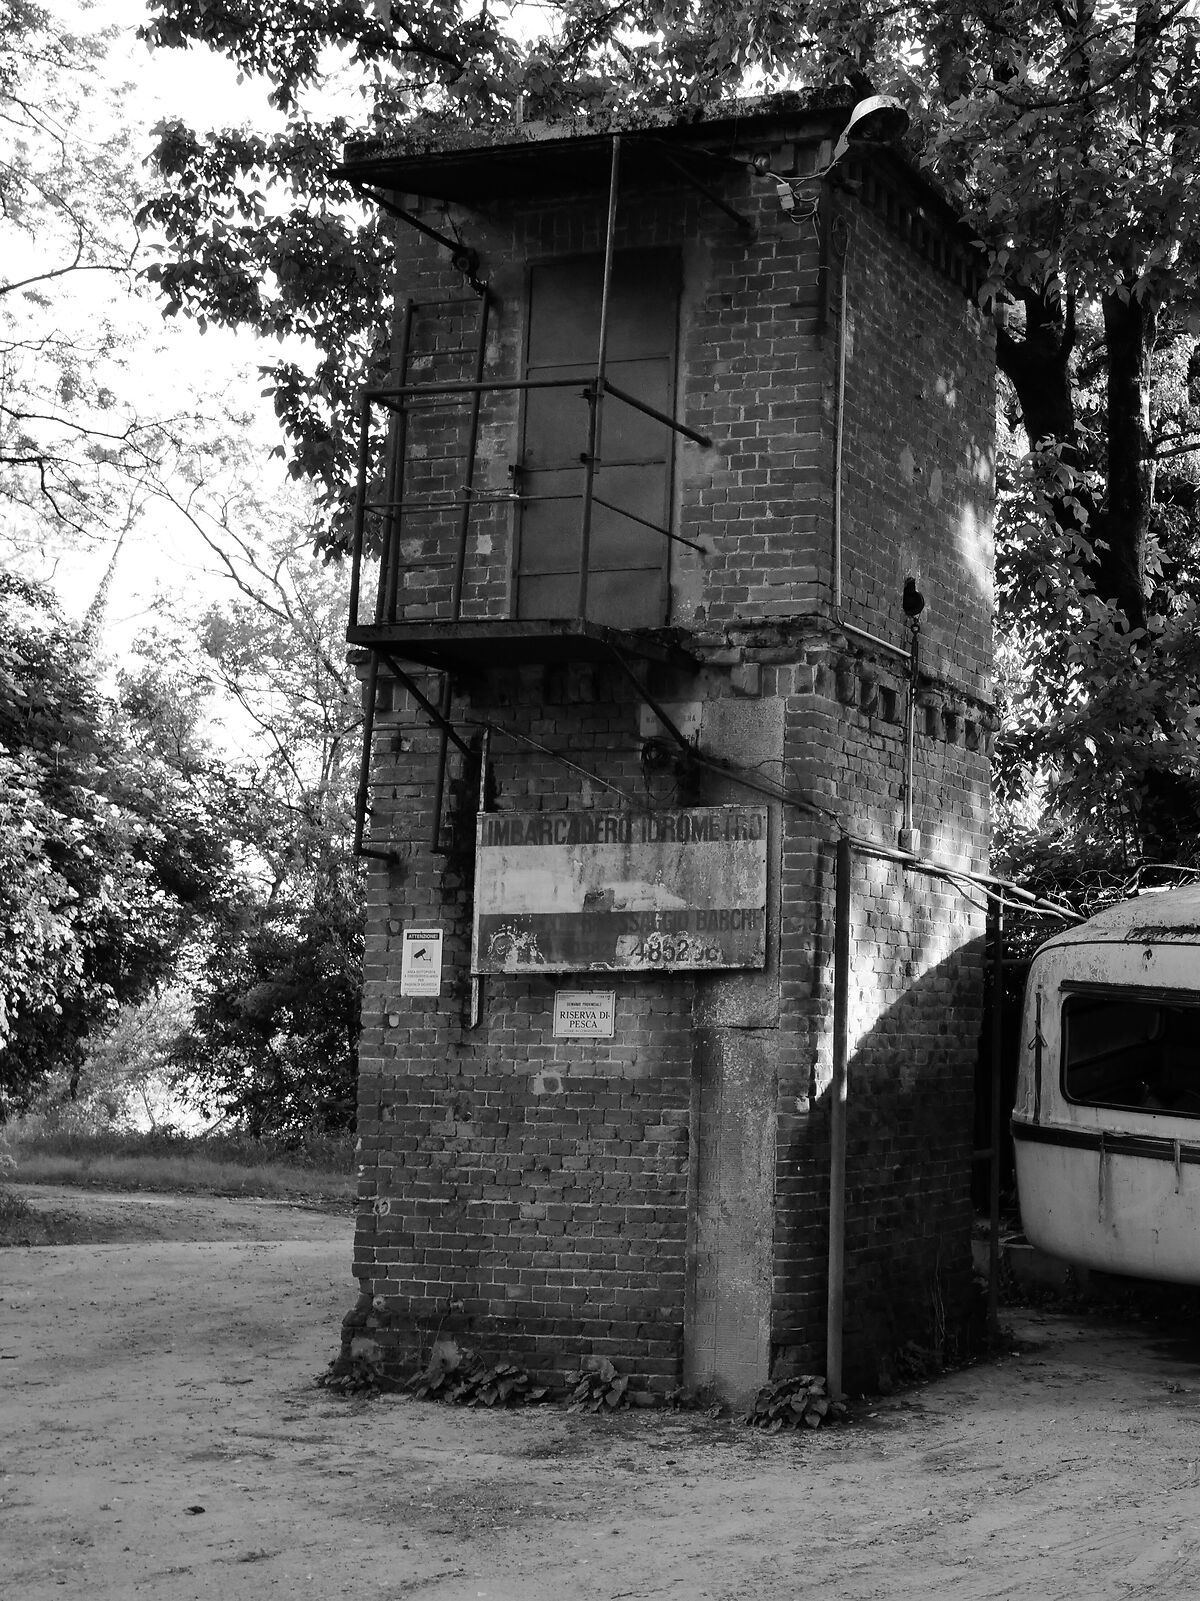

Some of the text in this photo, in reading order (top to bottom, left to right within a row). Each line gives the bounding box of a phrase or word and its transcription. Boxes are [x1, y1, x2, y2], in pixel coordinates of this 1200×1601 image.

[487, 813, 763, 846] IMBARCADERO IDROMETRO
[560, 1011, 596, 1019] RISERVA
[569, 1020, 597, 1028] PESCA
